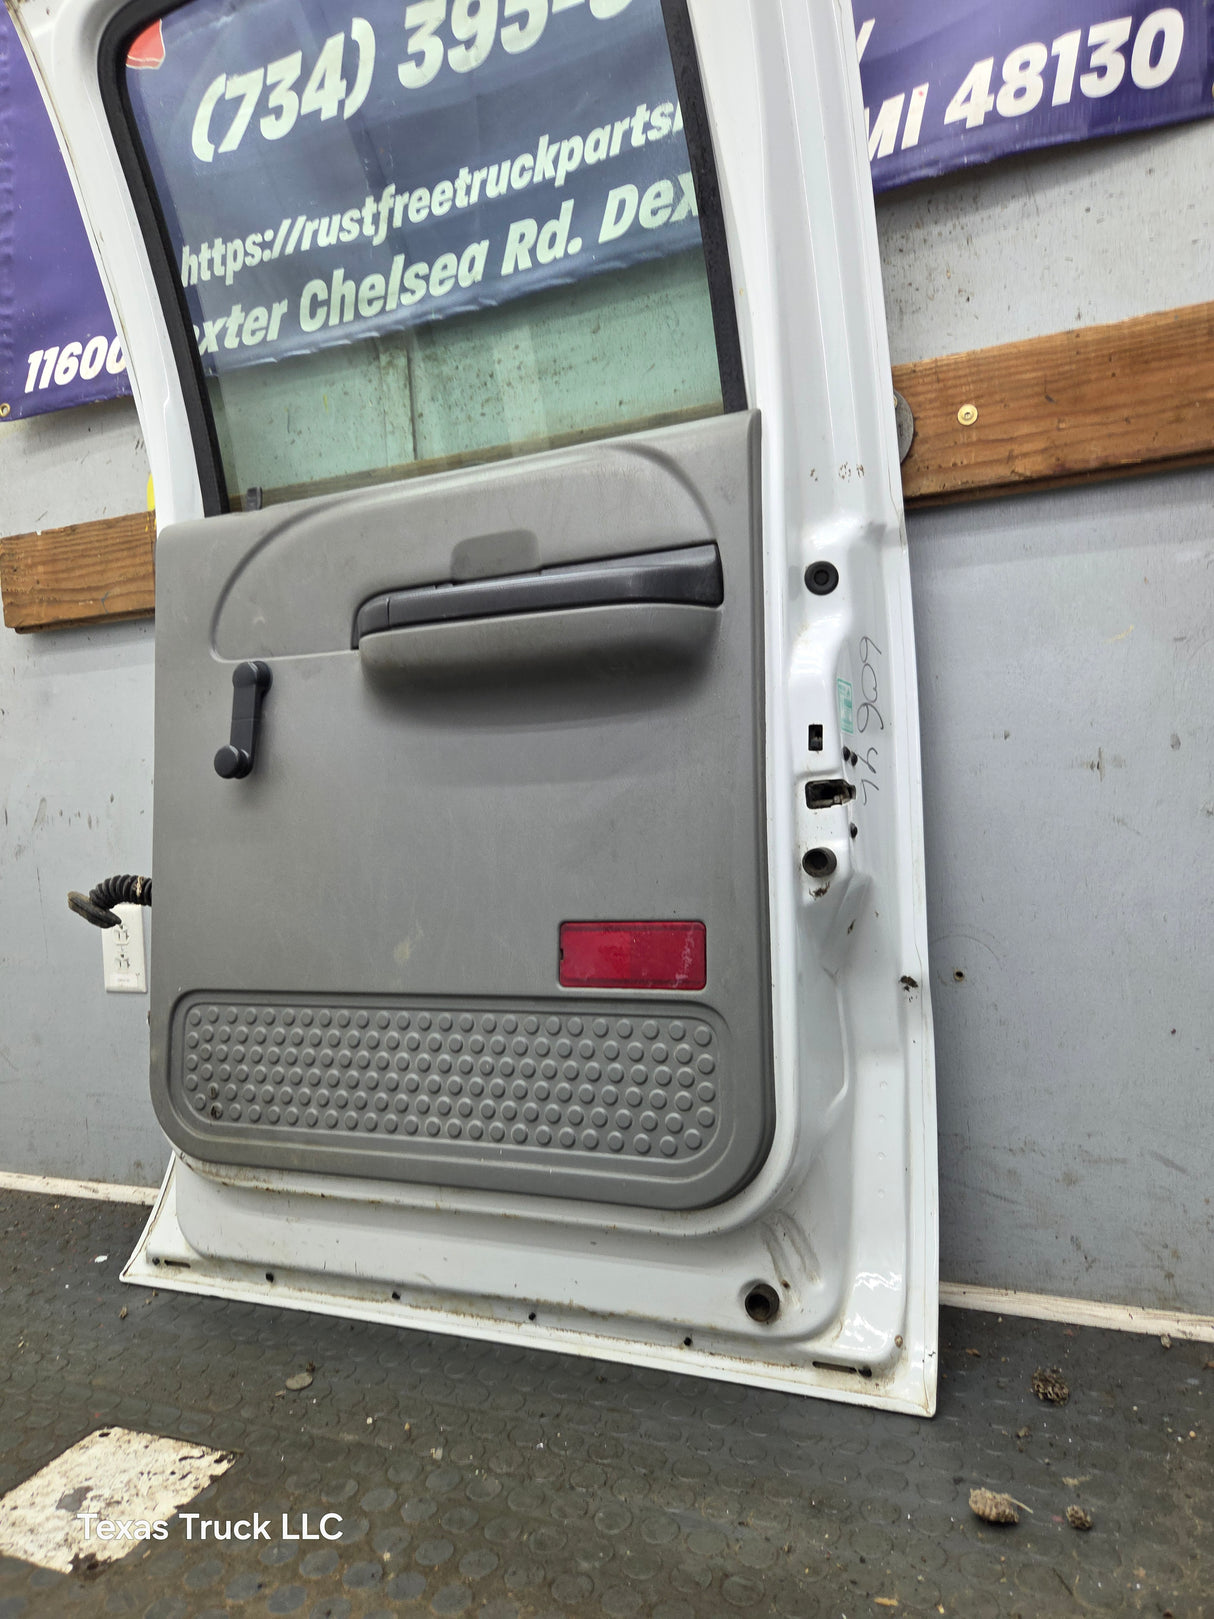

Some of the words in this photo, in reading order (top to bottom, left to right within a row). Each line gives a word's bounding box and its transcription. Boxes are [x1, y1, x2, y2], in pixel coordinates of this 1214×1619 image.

[191, 17, 376, 162] (734)
[397, 0, 634, 89] 395-
[193, 298, 288, 356] xter
[300, 240, 489, 333] Chelsea
[501, 198, 582, 277] Rd.
[944, 7, 1185, 129] 48130
